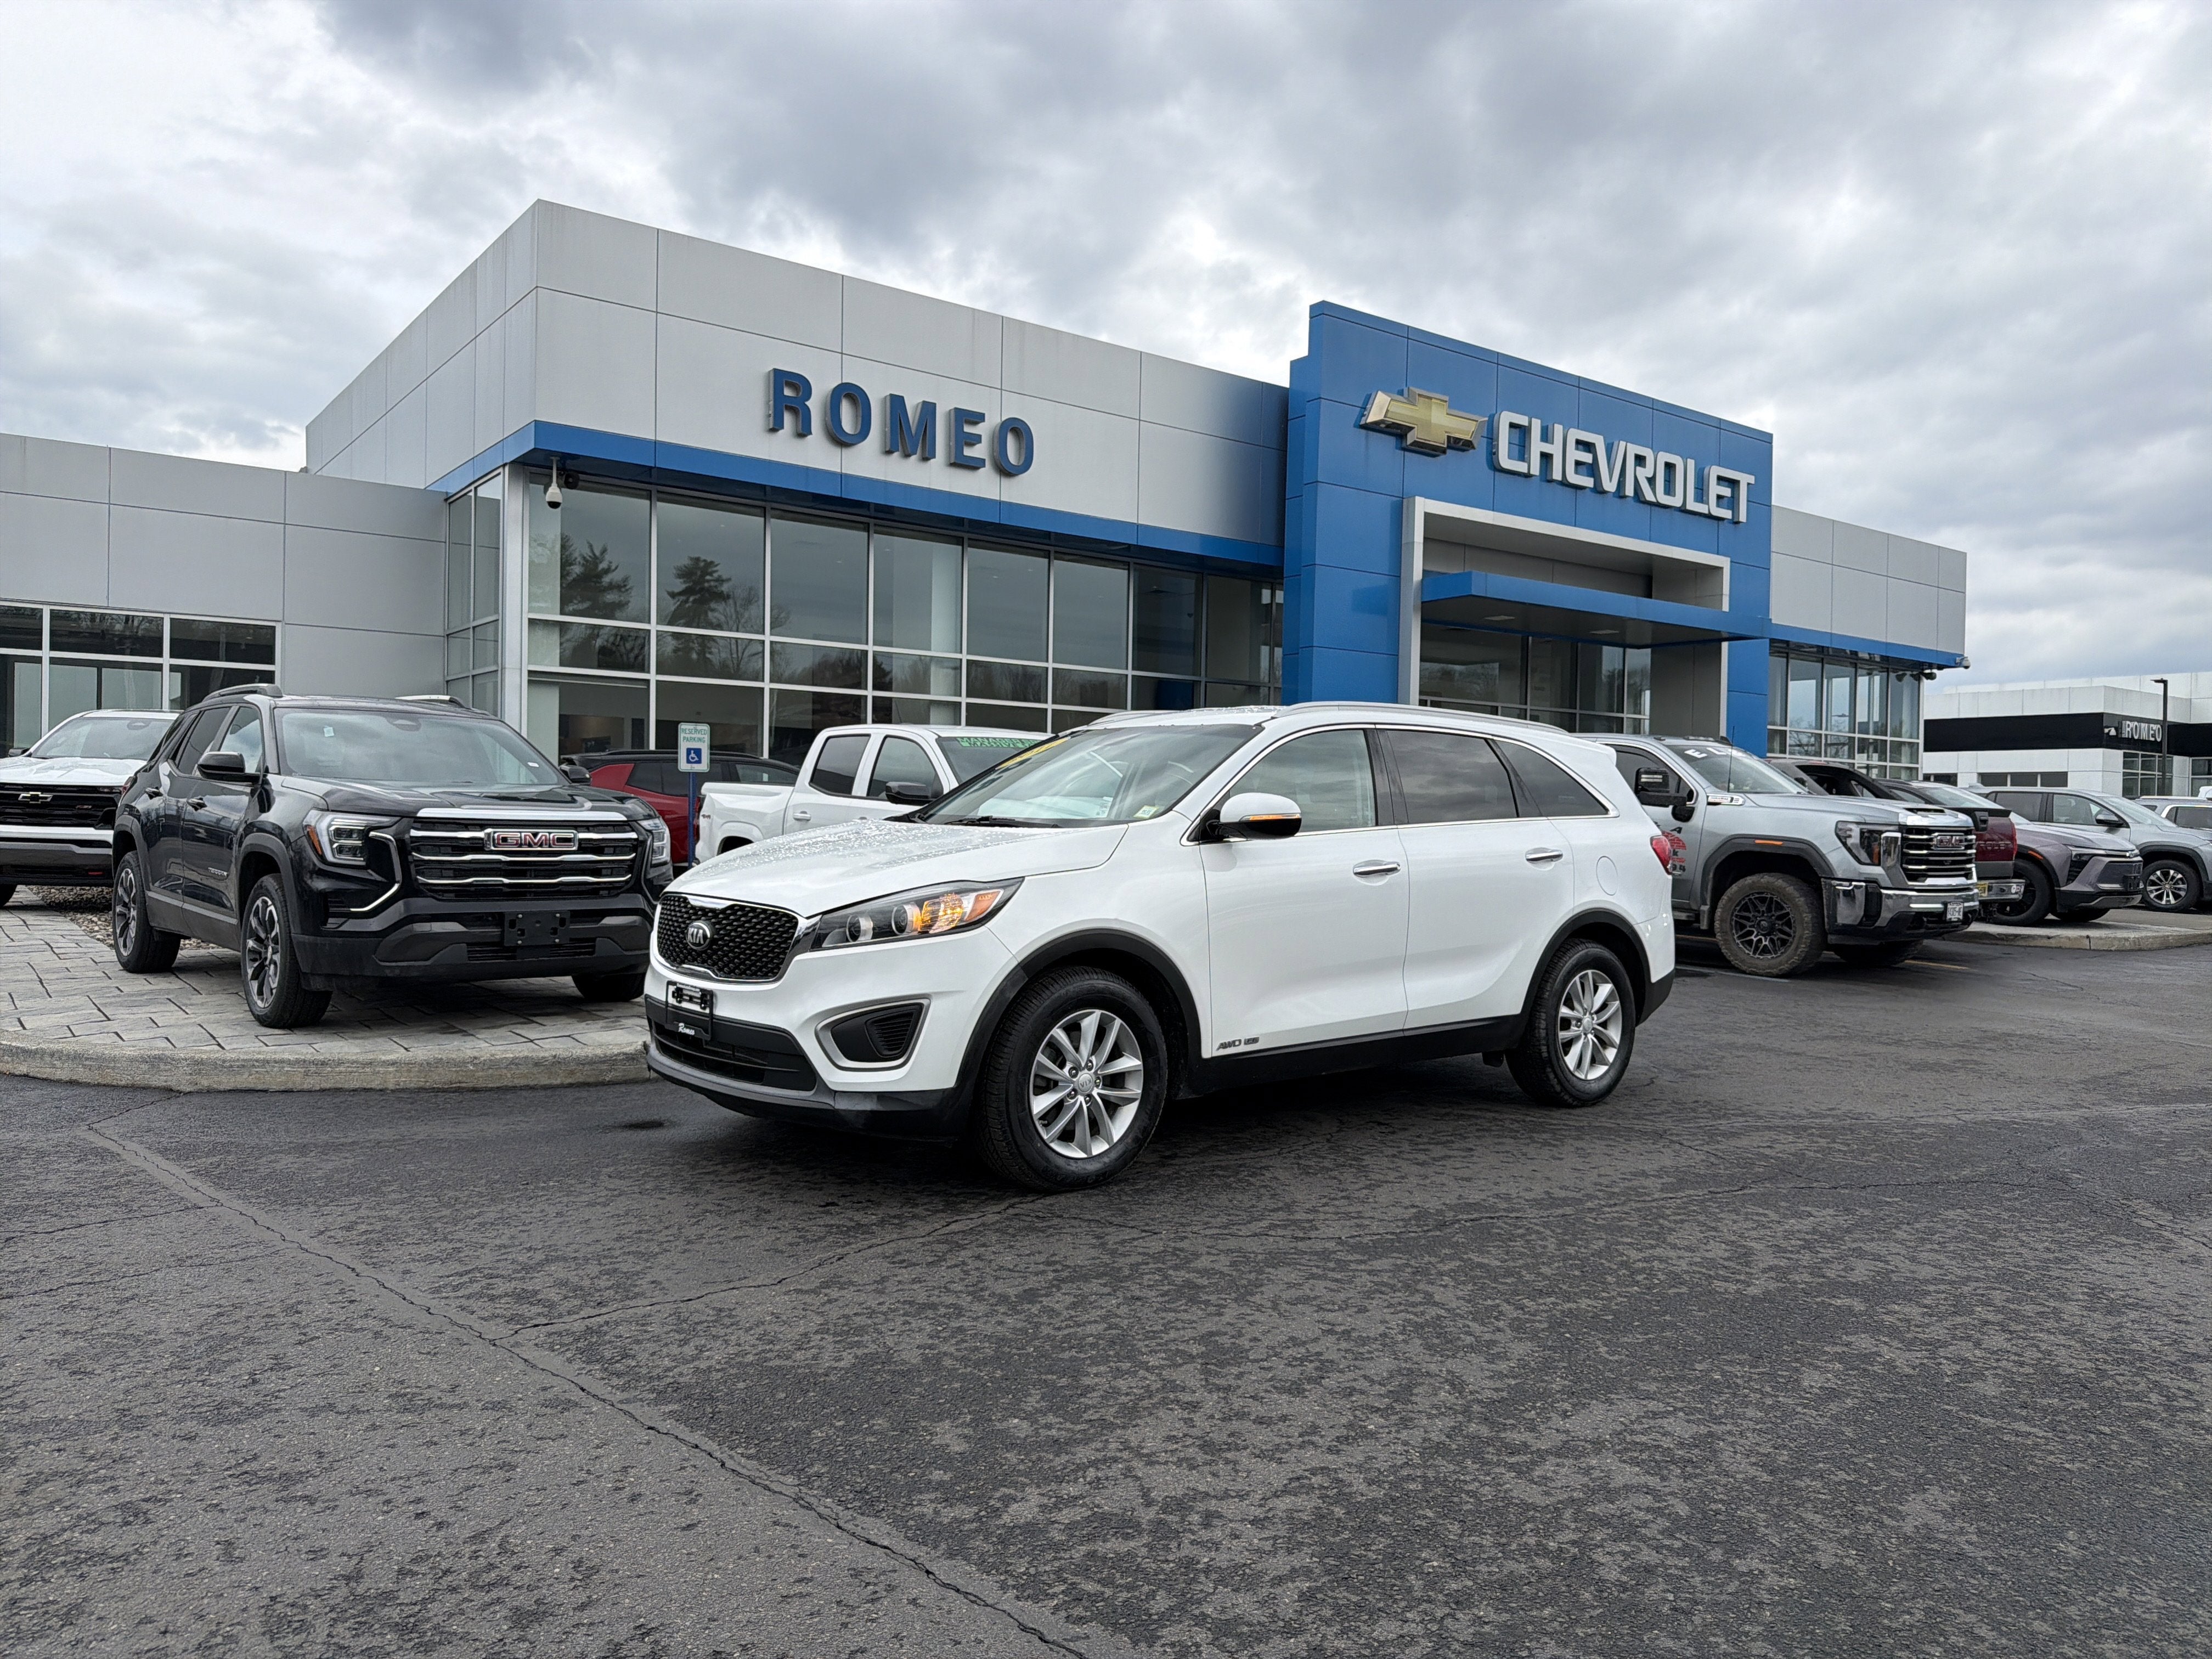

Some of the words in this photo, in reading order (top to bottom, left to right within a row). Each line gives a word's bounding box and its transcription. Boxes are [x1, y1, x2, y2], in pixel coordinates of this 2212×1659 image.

[768, 368, 1034, 476] ROMEO
[1493, 410, 1755, 524] CHEVROLET
[2121, 720, 2162, 742] ROMEO
[494, 832, 574, 848] GMC
[687, 927, 704, 944] KIA
